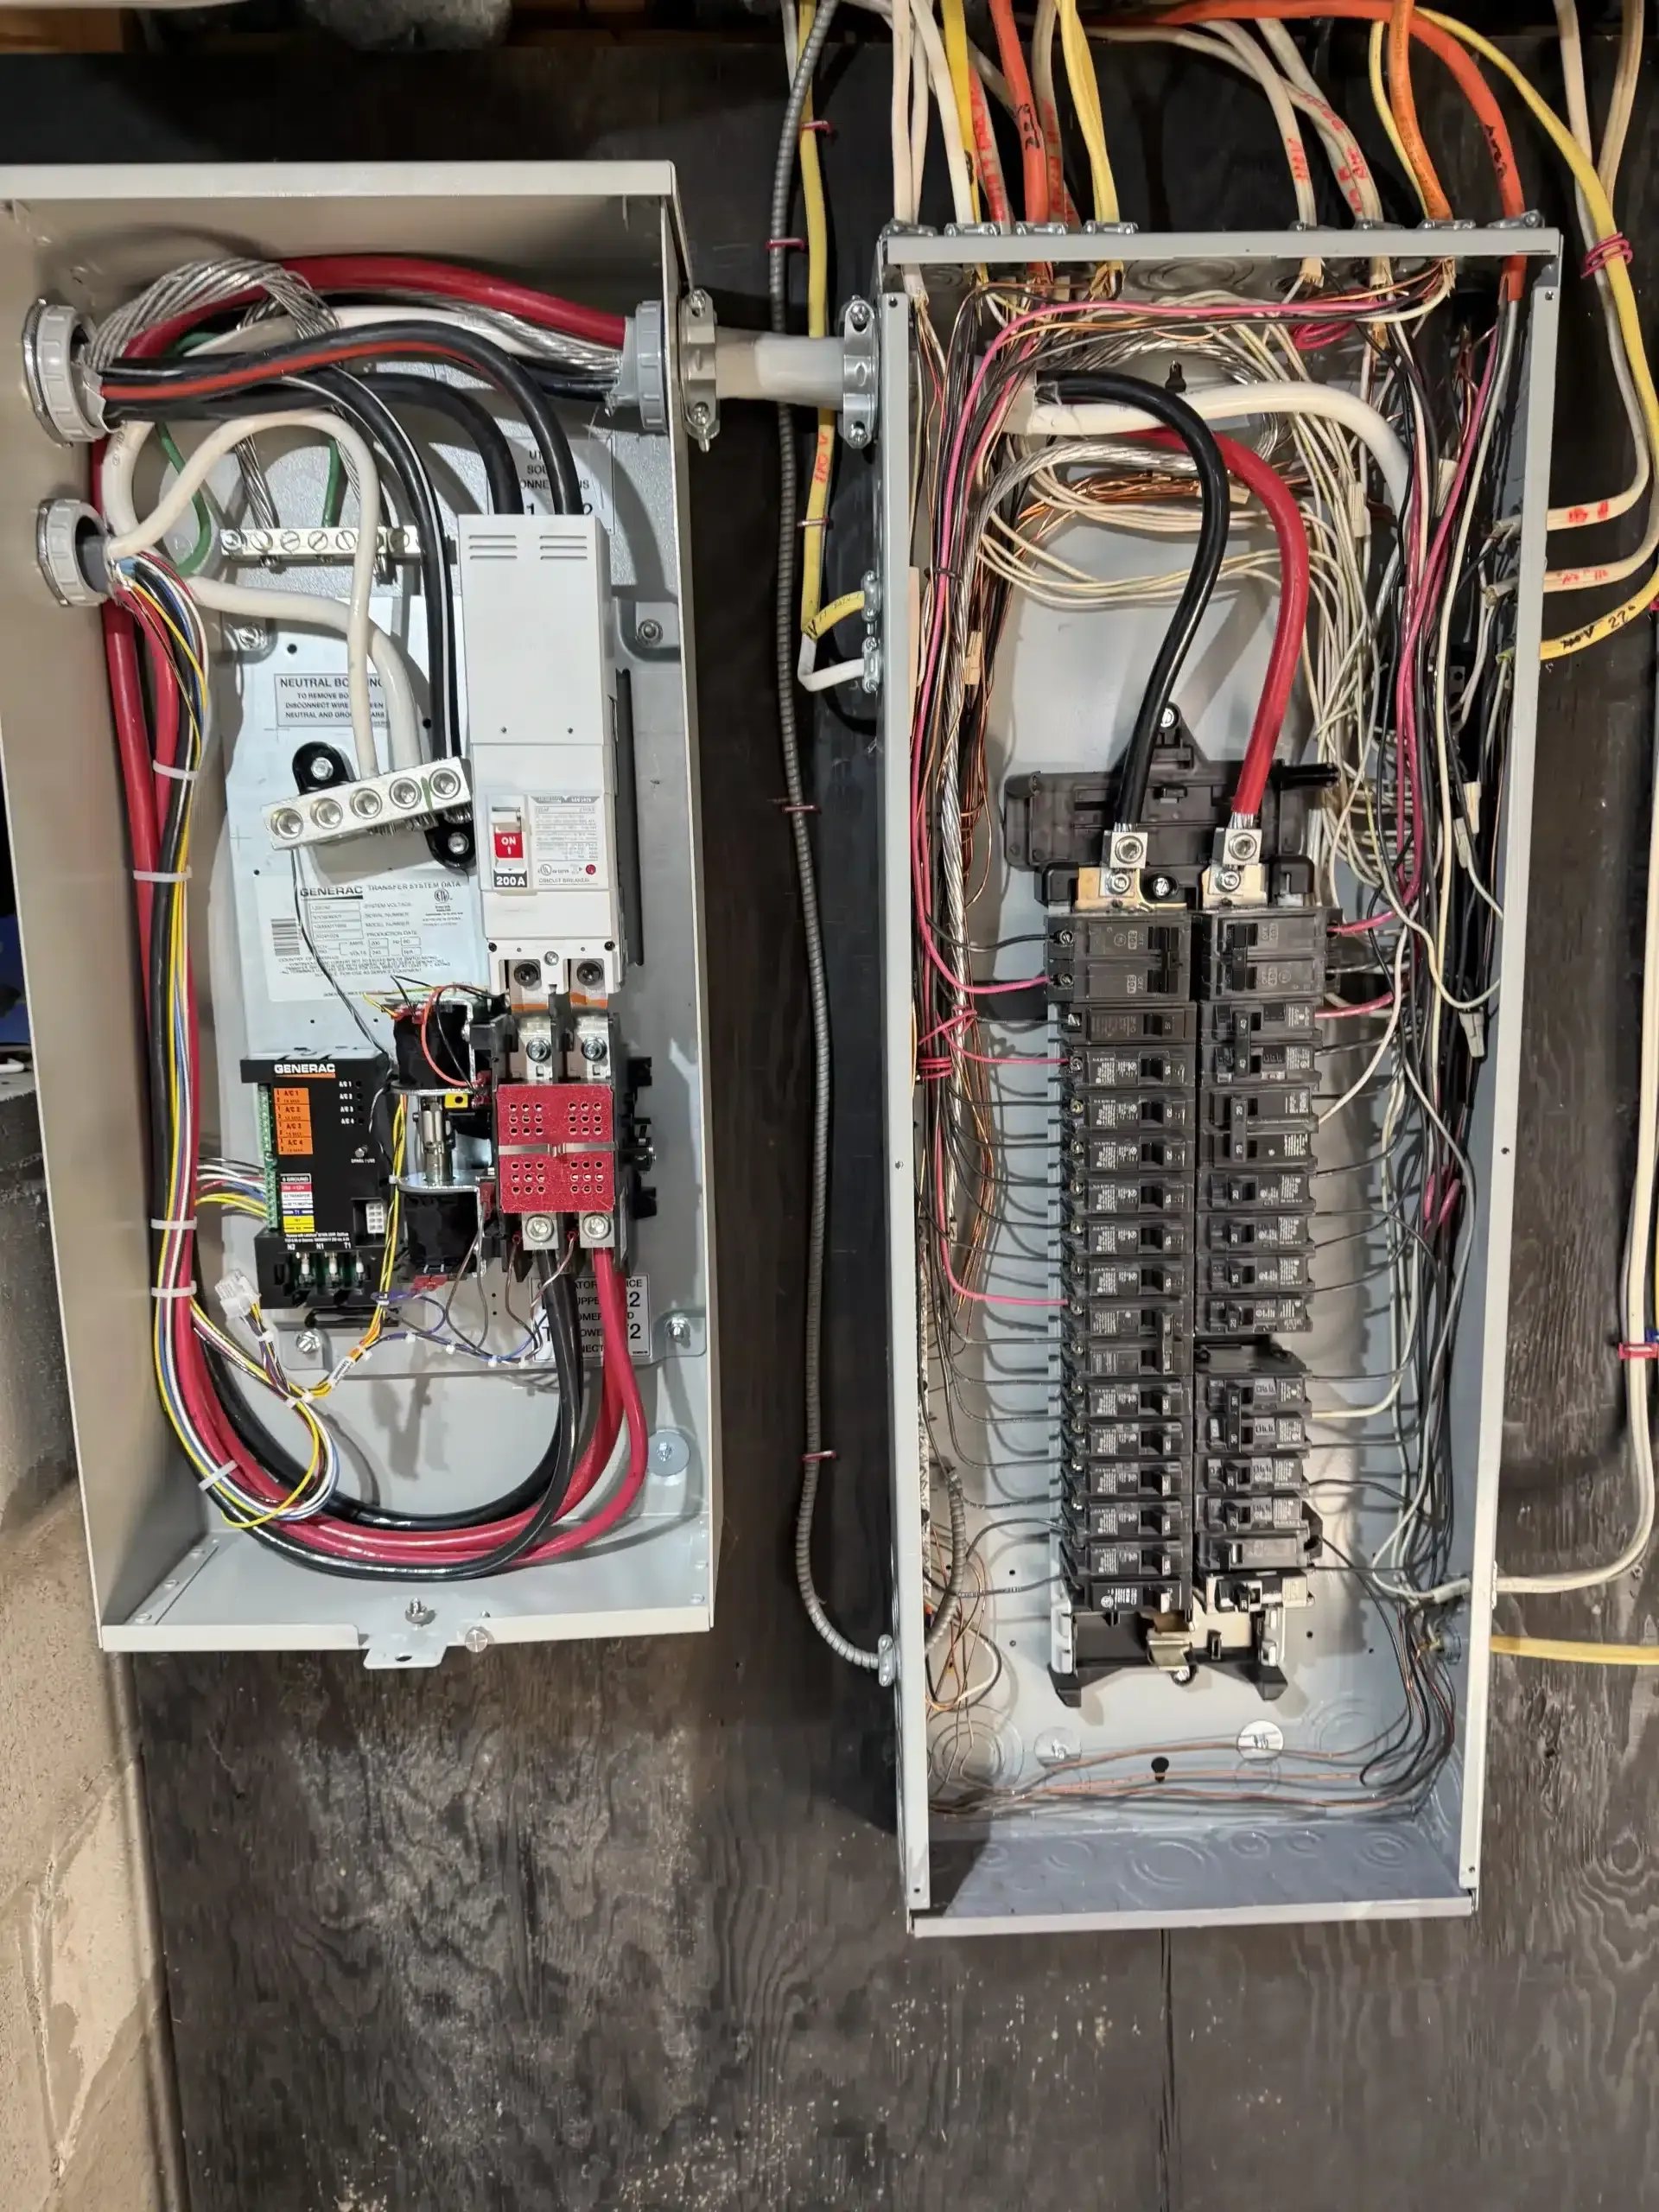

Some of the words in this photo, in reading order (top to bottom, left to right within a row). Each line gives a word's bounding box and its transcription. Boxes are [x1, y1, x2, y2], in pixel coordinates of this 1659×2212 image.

[280, 677, 332, 688] NEUTRAL
[501, 836, 517, 846] ON
[300, 886, 364, 896] GENERAC
[274, 1064, 336, 1074] GENERAC
